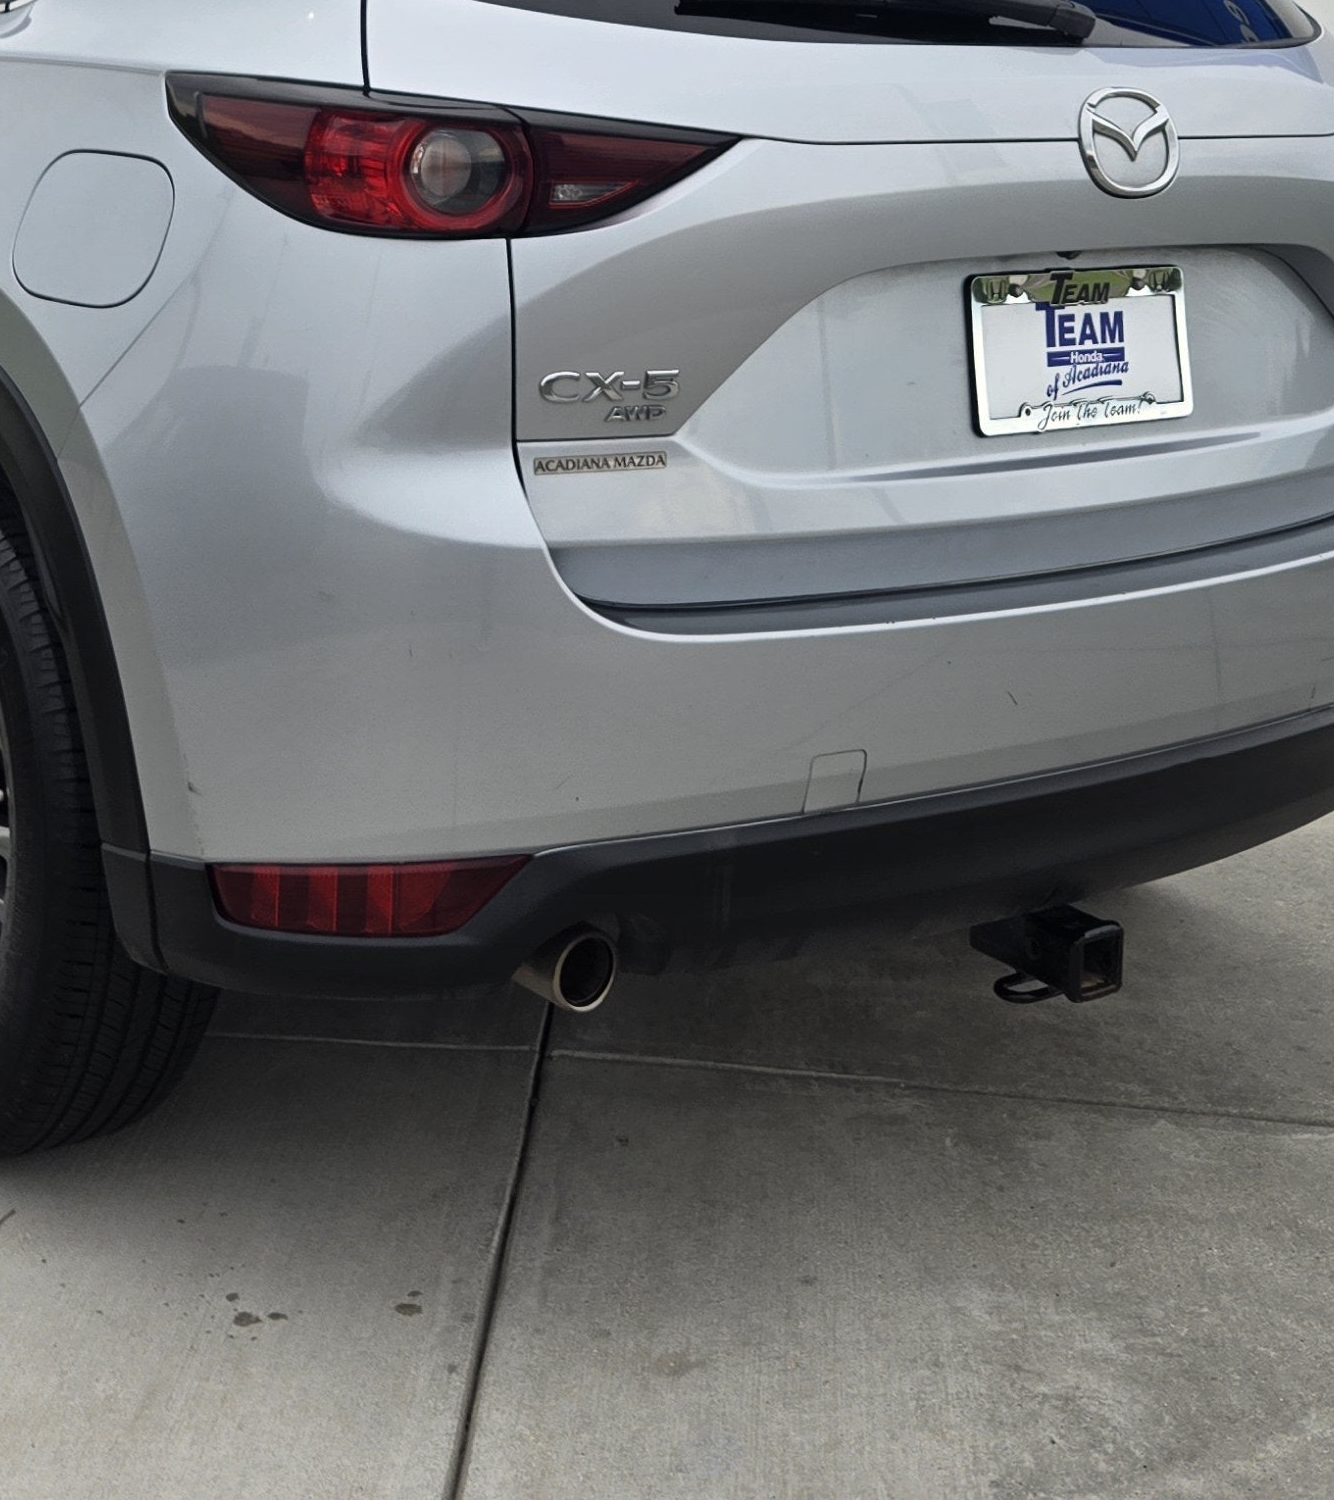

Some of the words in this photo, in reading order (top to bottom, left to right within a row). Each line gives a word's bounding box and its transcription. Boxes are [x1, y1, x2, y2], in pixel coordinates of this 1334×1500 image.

[1050, 271, 1110, 305] TEAM
[1035, 301, 1125, 348] TEAM
[1070, 350, 1103, 364] Honda
[538, 368, 680, 404] CX-5
[1046, 372, 1060, 401] of
[1062, 361, 1130, 388] Acadiana
[1037, 402, 1070, 430] Join
[1077, 402, 1097, 420] The
[535, 459, 610, 473] ACADIANA
[613, 454, 665, 469] MAZDA
